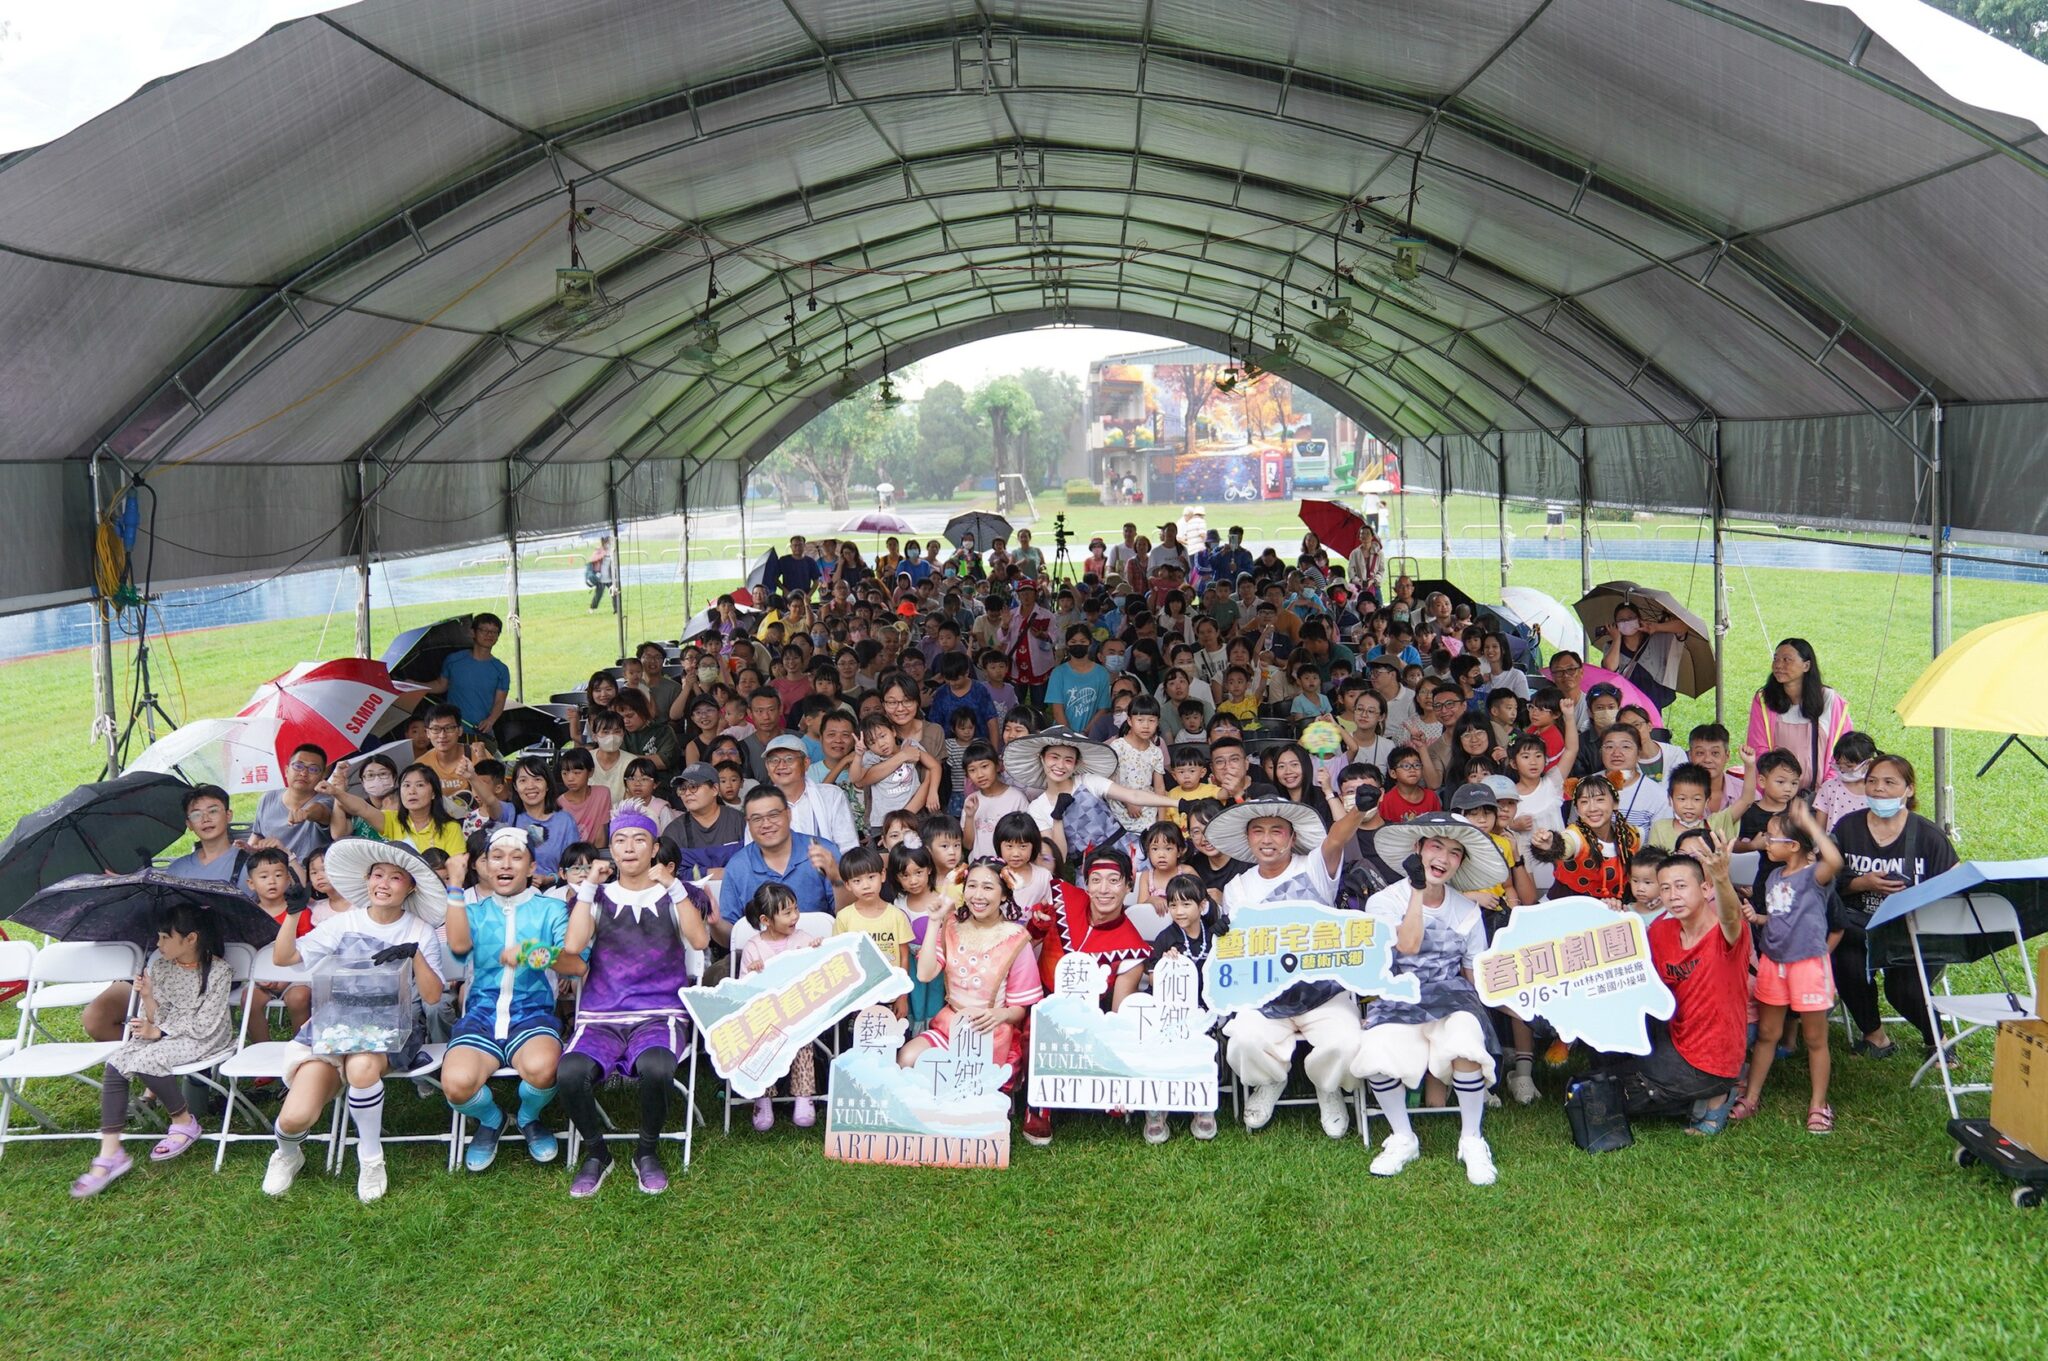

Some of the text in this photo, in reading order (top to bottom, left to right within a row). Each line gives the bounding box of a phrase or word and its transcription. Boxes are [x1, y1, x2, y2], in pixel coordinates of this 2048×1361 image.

[345, 693, 383, 734] SAMPO
[1216, 918, 1375, 959] 藝術宅急便
[1301, 950, 1364, 970] 藝術下鄉
[1482, 922, 1638, 993] 春河劇團
[711, 956, 853, 1067] 集章看表演
[1038, 1053, 1094, 1069] YUNLIN
[1036, 1078, 1213, 1107] ART DELIVERY
[834, 1109, 889, 1125] YUNLIN
[832, 1134, 1005, 1166] ART DELIVERY
